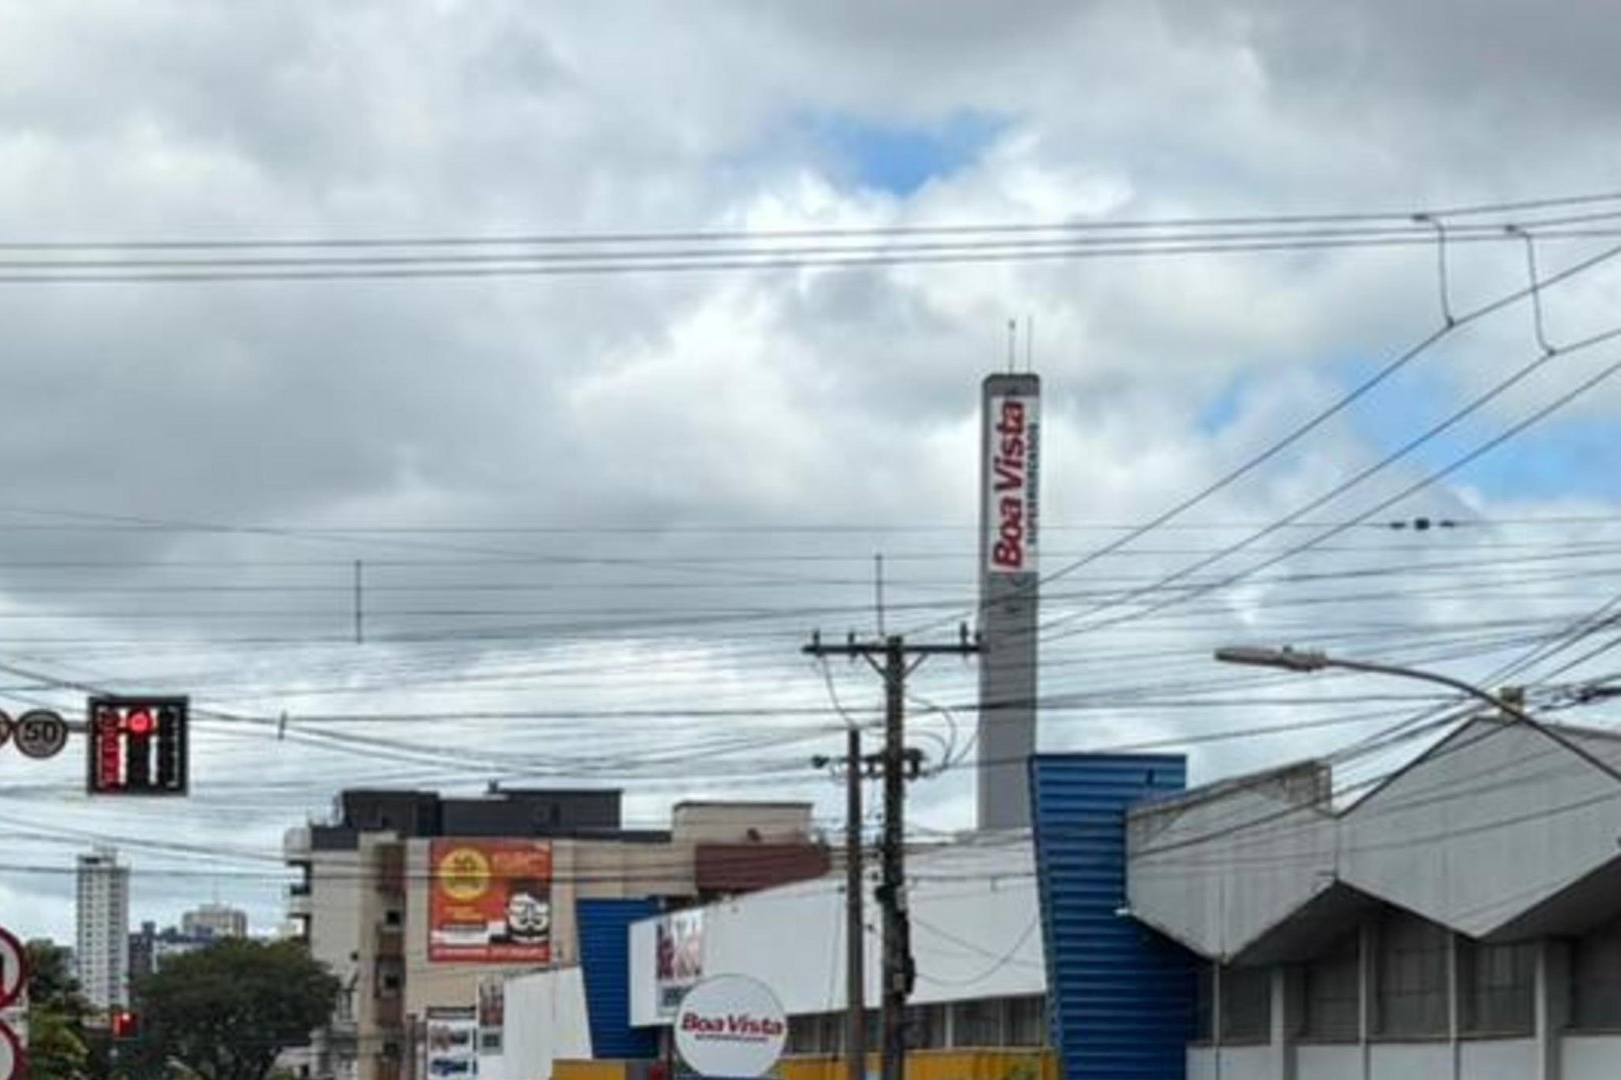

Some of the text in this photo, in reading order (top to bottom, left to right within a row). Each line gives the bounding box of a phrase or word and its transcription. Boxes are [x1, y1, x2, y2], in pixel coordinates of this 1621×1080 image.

[993, 400, 1025, 568] Boa Vista
[24, 720, 58, 744] 50
[681, 1013, 783, 1036] Boa Vista
